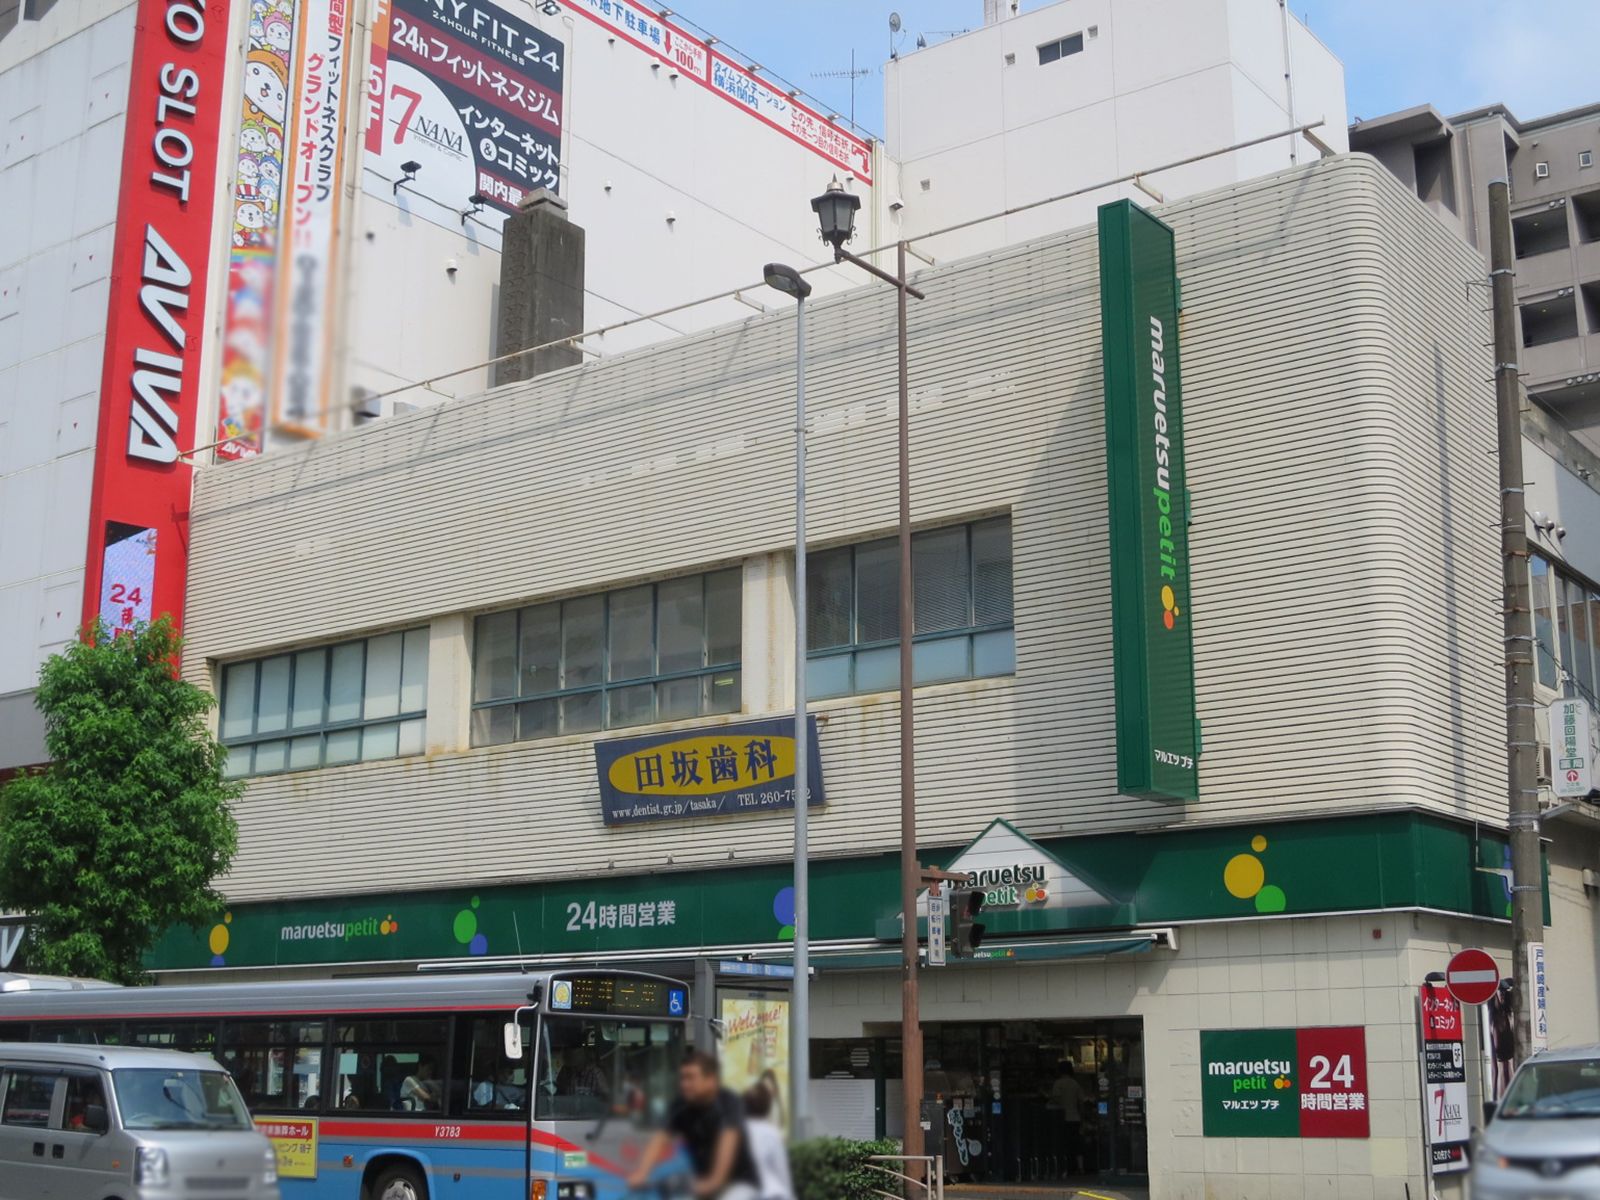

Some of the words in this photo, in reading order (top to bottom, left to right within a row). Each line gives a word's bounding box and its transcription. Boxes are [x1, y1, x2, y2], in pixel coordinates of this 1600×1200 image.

[432, 10, 478, 40] 24HOUR
[481, 37, 525, 66] FITNESS
[473, 8, 519, 48] FIT
[523, 37, 560, 73] 24
[392, 18, 560, 126] 24hフィットネスジム
[390, 84, 422, 144] 7
[151, 62, 199, 202] SLOT
[415, 115, 463, 152] NANA
[459, 105, 560, 165] インターネット
[479, 172, 526, 207] 関内最
[128, 223, 192, 463] AVIVA
[109, 583, 142, 606] 24
[634, 739, 778, 791] 田坂歯科
[1154, 749, 1179, 765] マルエツ
[737, 793, 758, 807] TEL
[760, 788, 811, 805] 260-752
[566, 900, 676, 931] 24時間営業
[1208, 1059, 1291, 1075] maruetsu
[1233, 1075, 1267, 1093] petit
[1309, 1055, 1354, 1089] 24
[1222, 1099, 1259, 1110] マルエツ
[1261, 1099, 1279, 1110] プチ
[1301, 1092, 1364, 1110] 時間営業
[434, 1126, 460, 1138] Y3783
